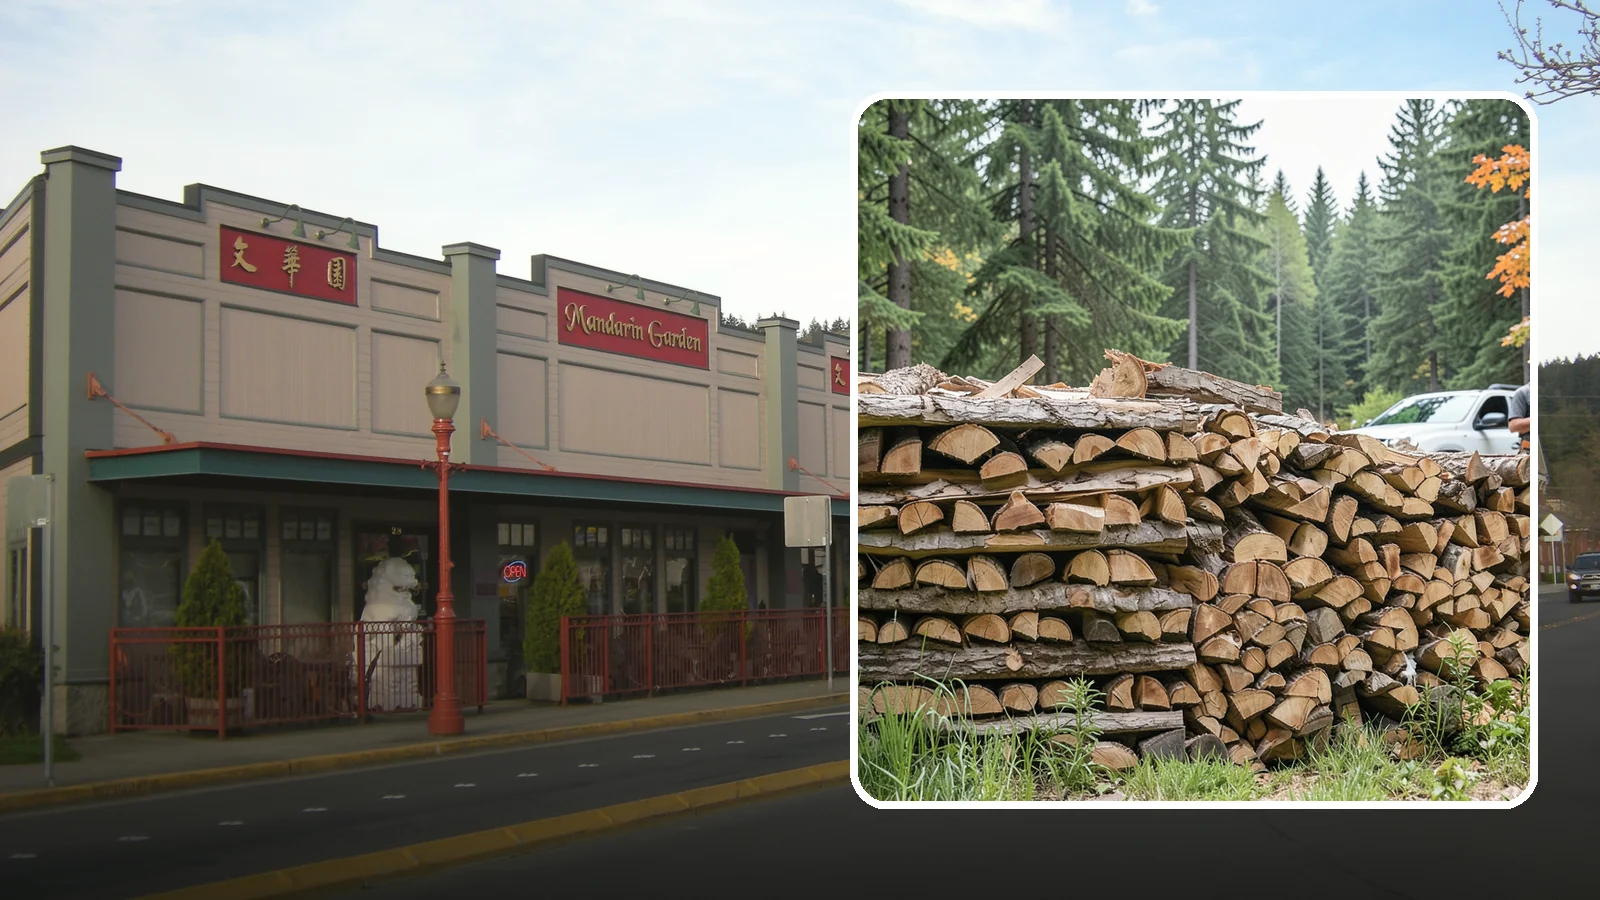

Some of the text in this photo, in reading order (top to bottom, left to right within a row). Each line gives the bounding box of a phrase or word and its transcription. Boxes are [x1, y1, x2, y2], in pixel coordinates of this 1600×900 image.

[230, 235, 346, 291] 文華園
[564, 302, 702, 352] Mandarin Garden
[503, 565, 526, 578] OPEN
